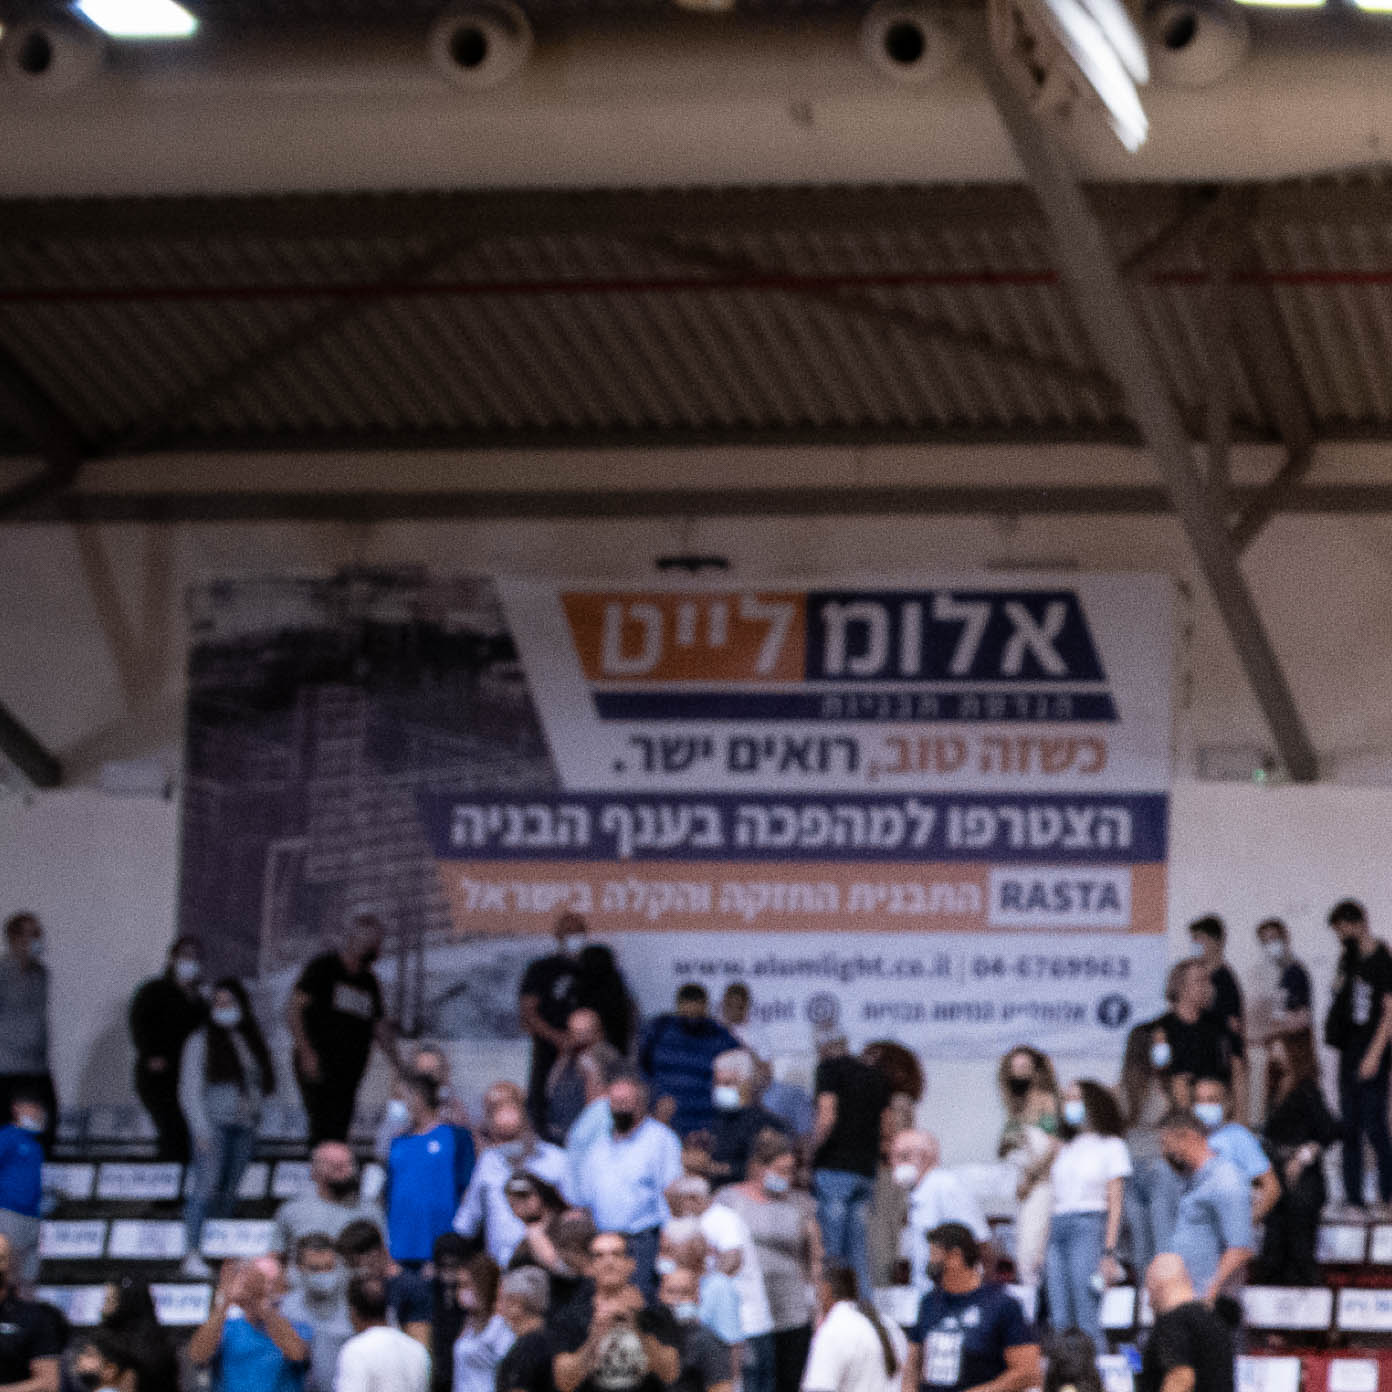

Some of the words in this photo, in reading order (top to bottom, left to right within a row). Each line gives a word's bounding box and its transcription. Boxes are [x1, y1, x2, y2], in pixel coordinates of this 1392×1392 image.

[612, 734, 713, 775] ישר.
[728, 734, 860, 774] רואים
[978, 734, 1108, 775] כשזה
[451, 806, 590, 848] הבניה
[601, 806, 725, 858] בענף
[735, 799, 937, 848] למהפכה
[950, 804, 1133, 848] הצטרפו
[1001, 880, 1122, 913] RASTA
